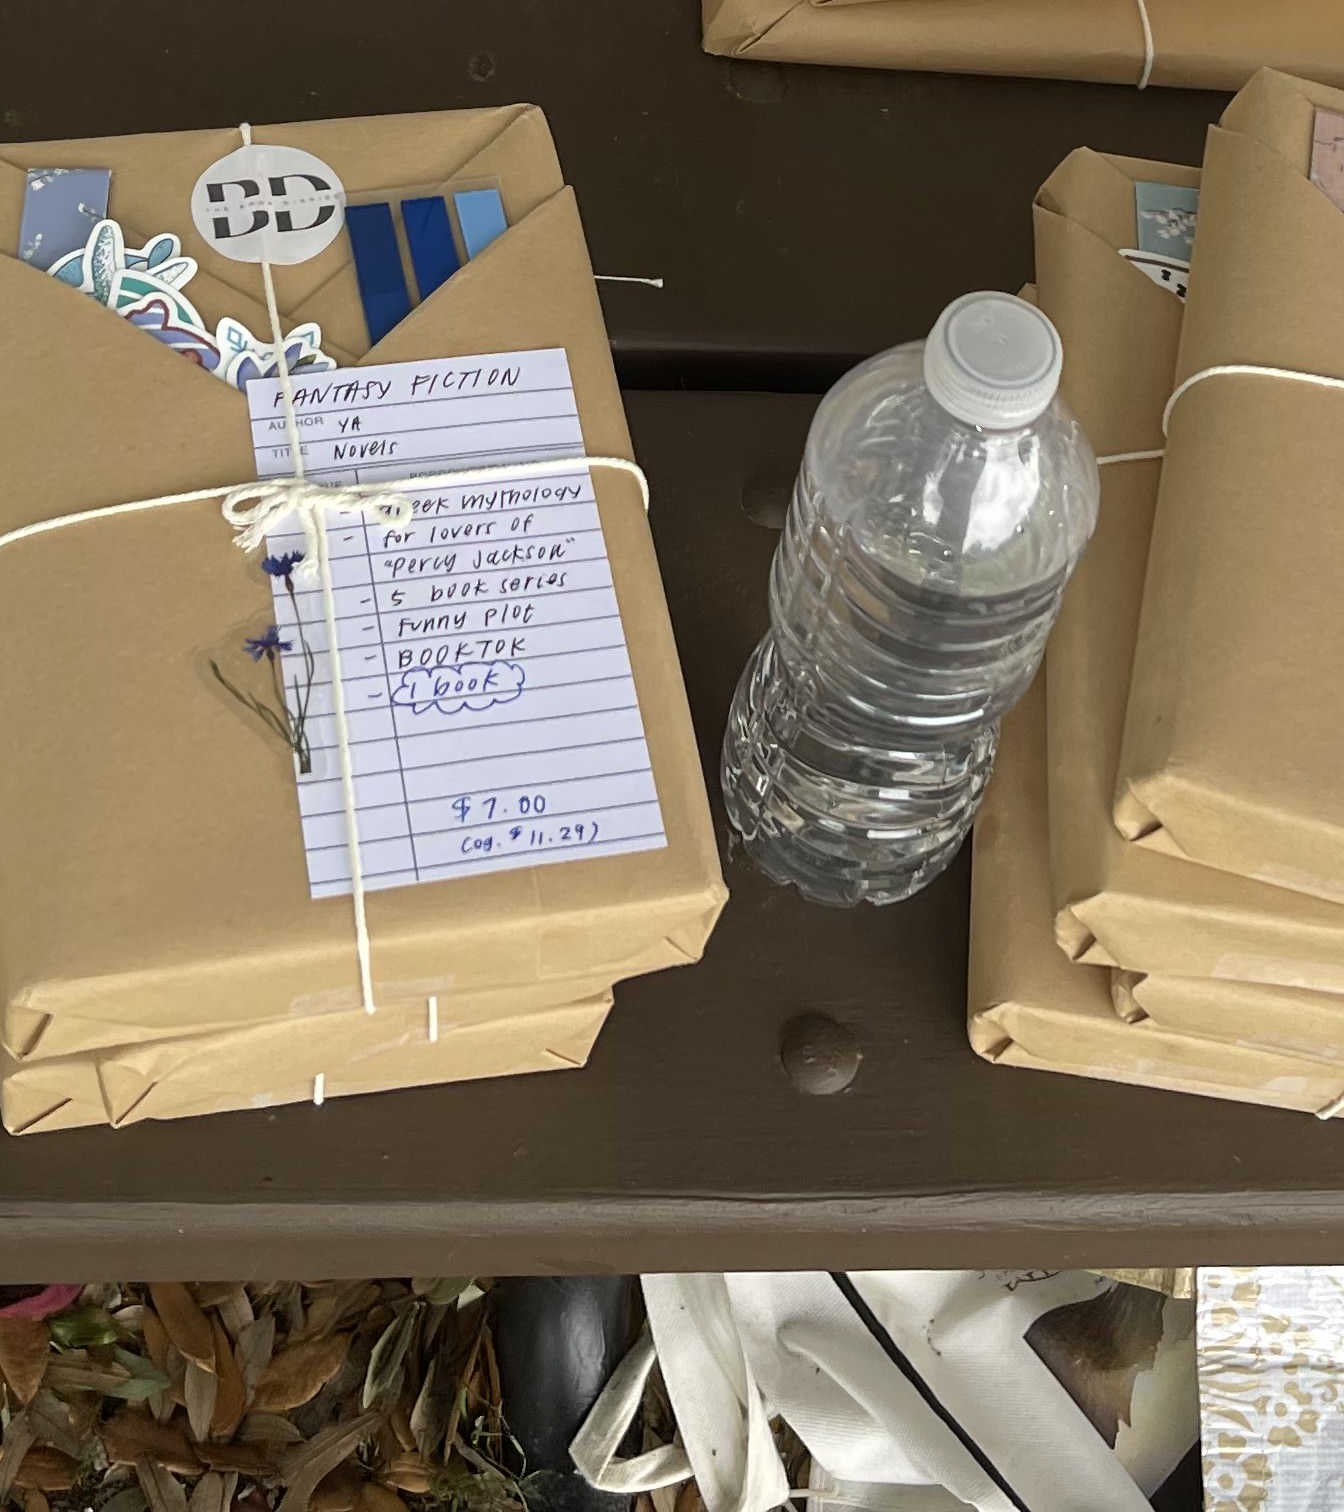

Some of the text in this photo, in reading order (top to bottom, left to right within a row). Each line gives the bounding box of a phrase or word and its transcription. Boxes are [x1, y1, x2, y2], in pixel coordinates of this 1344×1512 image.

[206, 174, 335, 239] BD
[411, 367, 522, 396] FICTION
[268, 415, 324, 431] AUHOR
[338, 417, 362, 433] YA
[272, 445, 309, 459] TITE
[334, 440, 398, 459] Novels
[461, 485, 582, 509] mythology
[383, 513, 534, 548] for lovers of
[391, 572, 567, 606] 5 book series
[410, 670, 499, 698] 1 book
